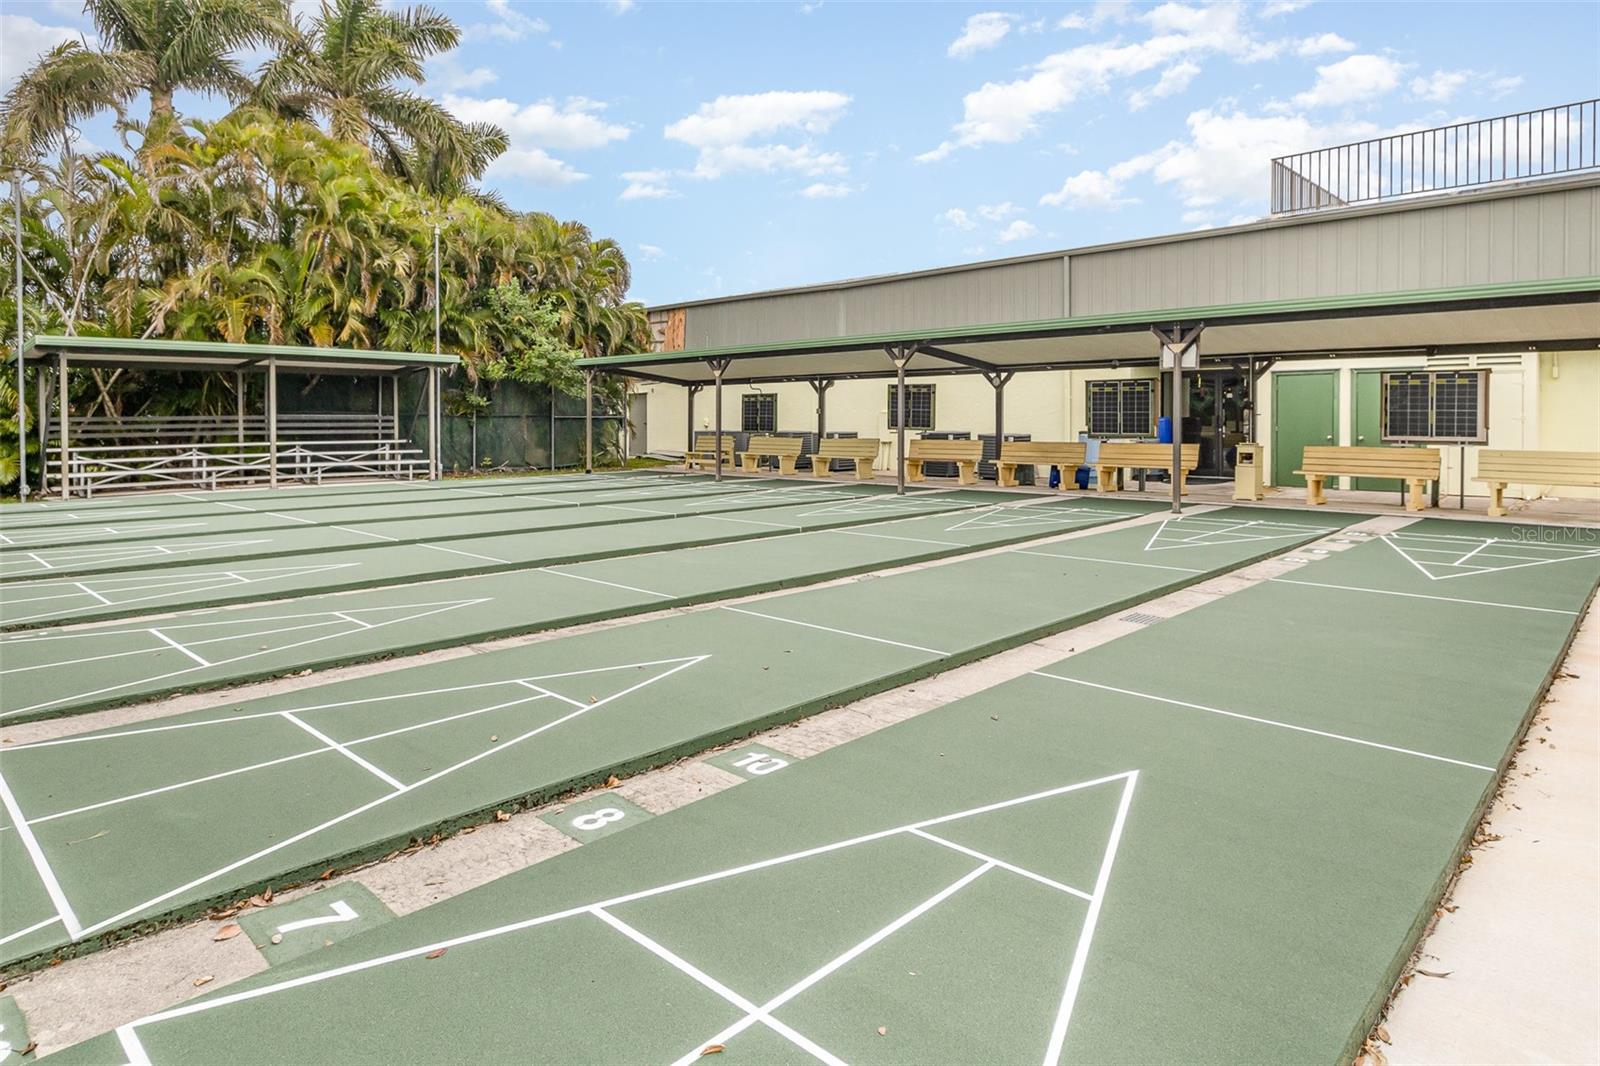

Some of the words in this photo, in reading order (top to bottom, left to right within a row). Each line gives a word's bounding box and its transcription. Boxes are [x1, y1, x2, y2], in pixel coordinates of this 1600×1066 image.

[732, 752, 790, 775] 10
[572, 807, 626, 831] 8
[276, 900, 360, 934] 7
